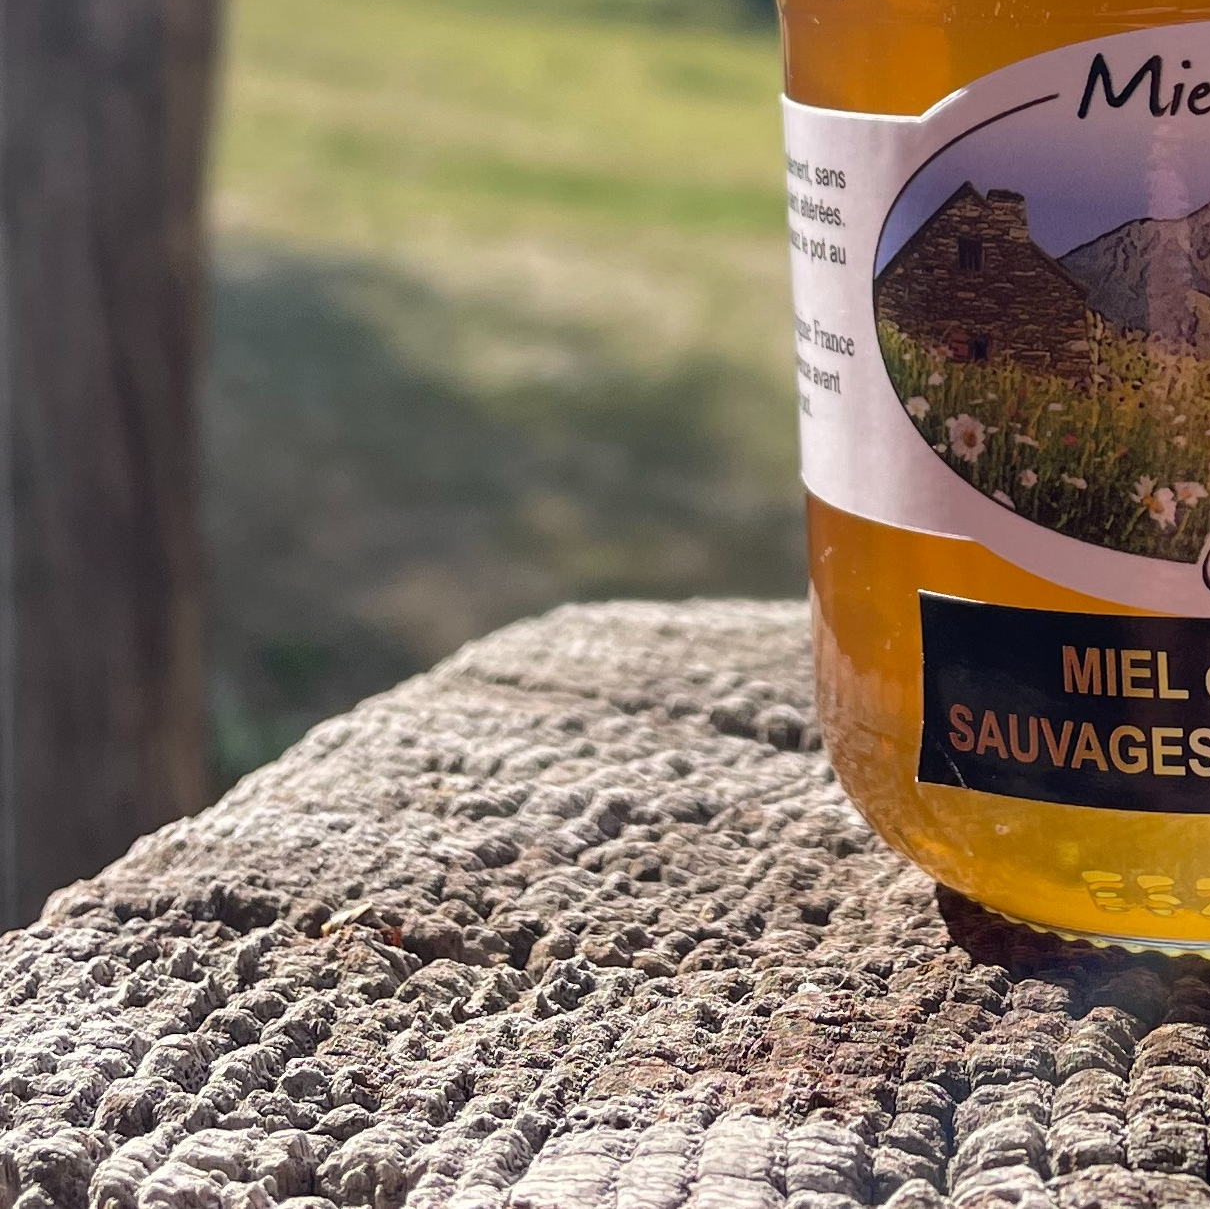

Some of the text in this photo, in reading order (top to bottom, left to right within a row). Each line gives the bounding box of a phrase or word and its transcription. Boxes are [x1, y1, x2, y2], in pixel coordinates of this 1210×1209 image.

[815, 166, 846, 189] sans
[810, 238, 827, 263] pot
[829, 243, 847, 265] au
[813, 318, 855, 357] France
[813, 366, 842, 395] avant
[1062, 643, 1190, 700] MIEL
